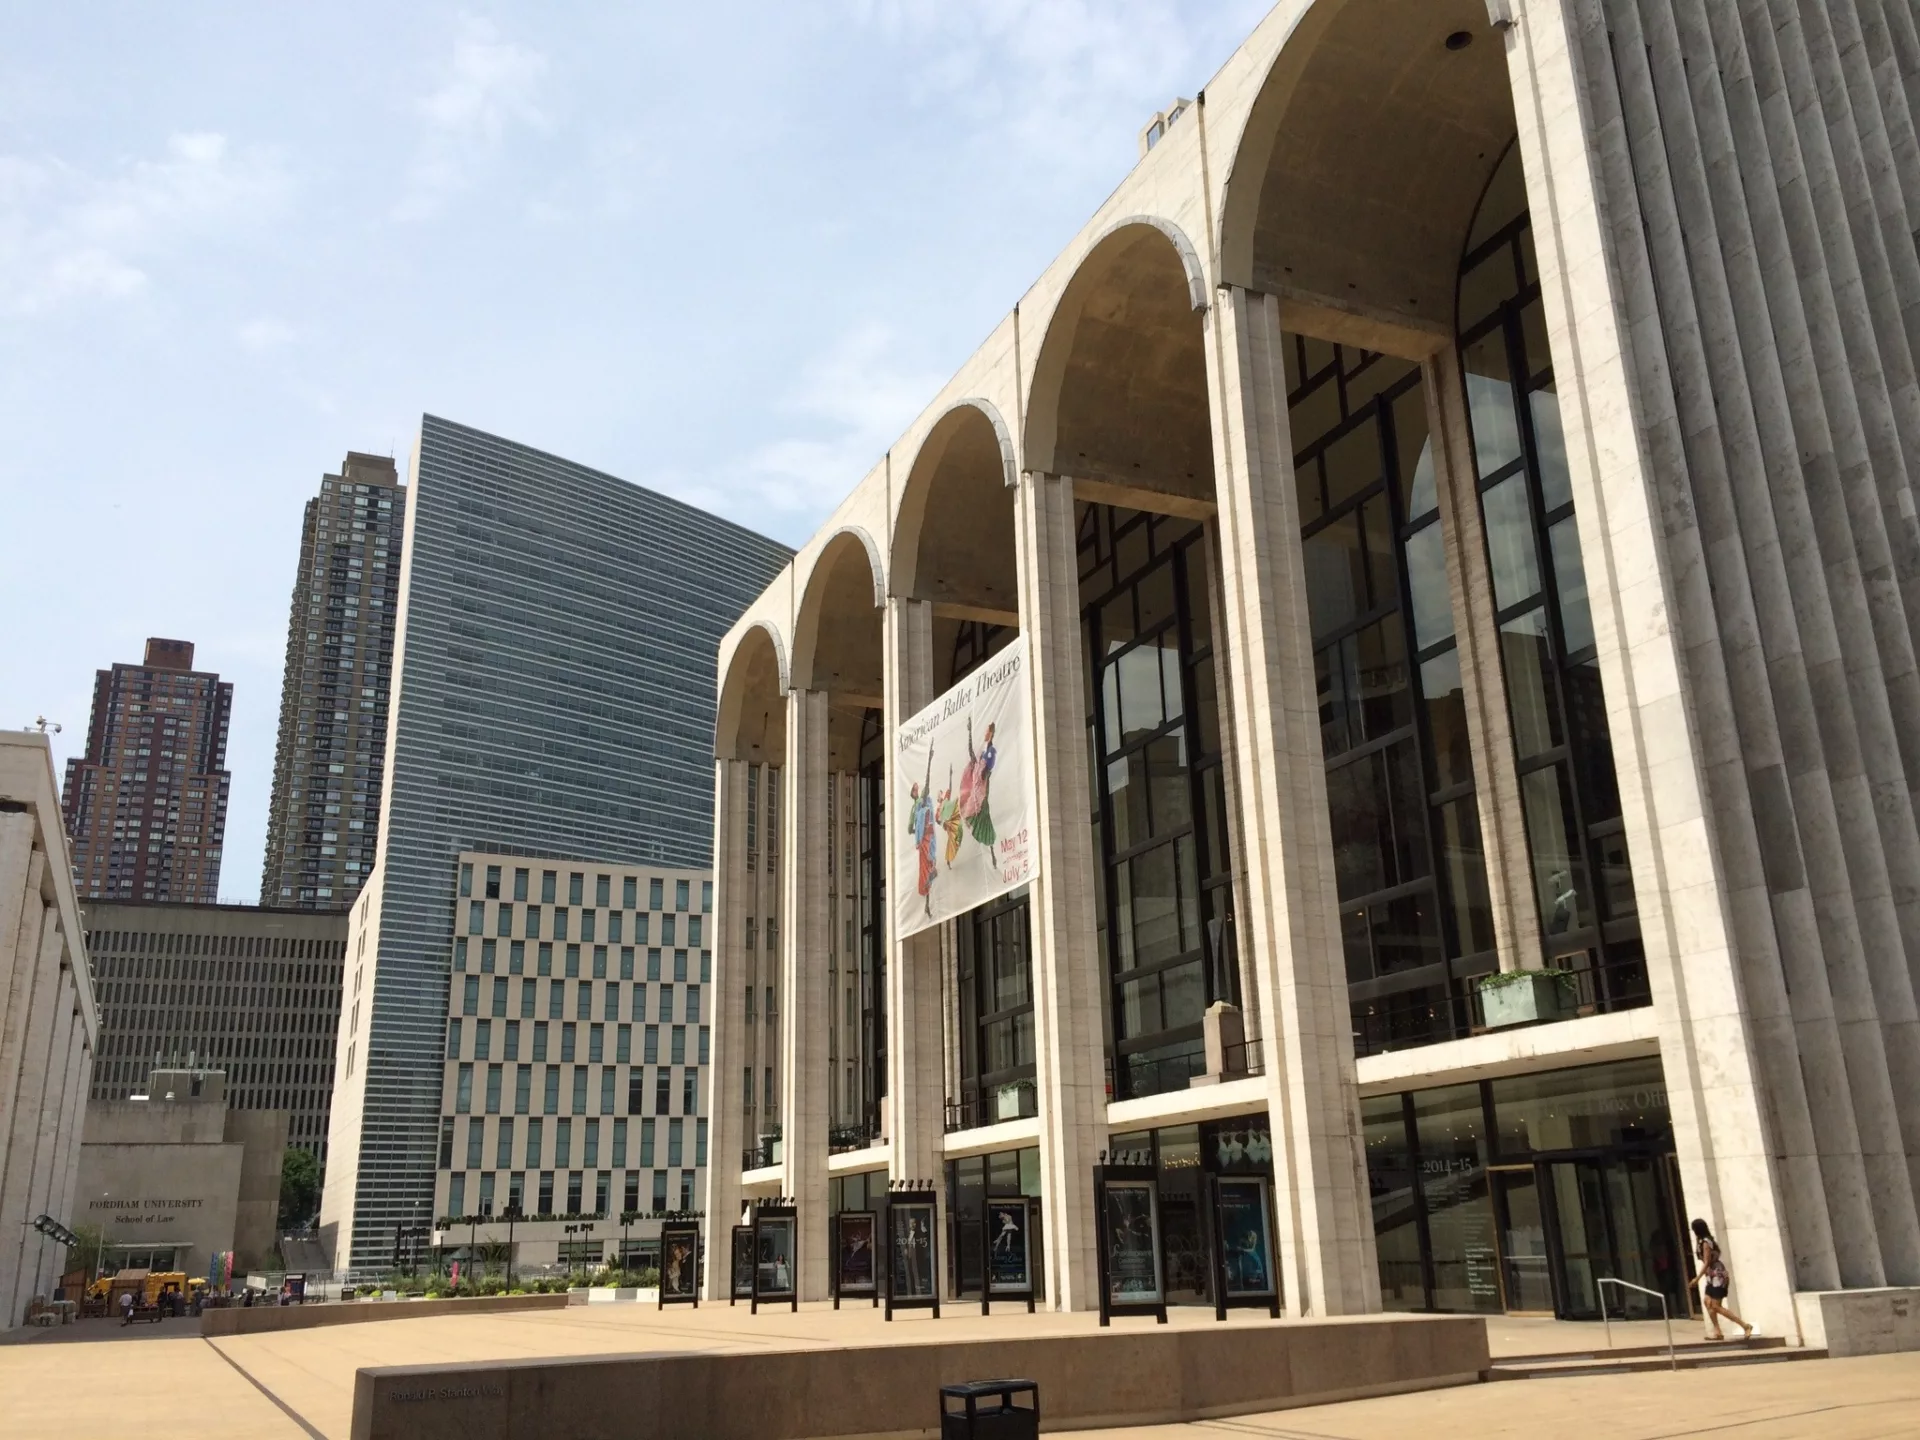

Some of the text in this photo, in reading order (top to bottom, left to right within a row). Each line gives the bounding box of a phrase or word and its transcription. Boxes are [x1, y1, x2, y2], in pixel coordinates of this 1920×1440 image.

[899, 655, 1020, 752] American Ballet Theatre
[1001, 829, 1028, 853] May 12
[1003, 859, 1029, 883] July 5
[89, 1199, 204, 1210] FORDHAM UNIVERSITY
[115, 1214, 175, 1224] School of Law
[389, 1390, 425, 1401] Ronald
[440, 1386, 480, 1398] Stanton
